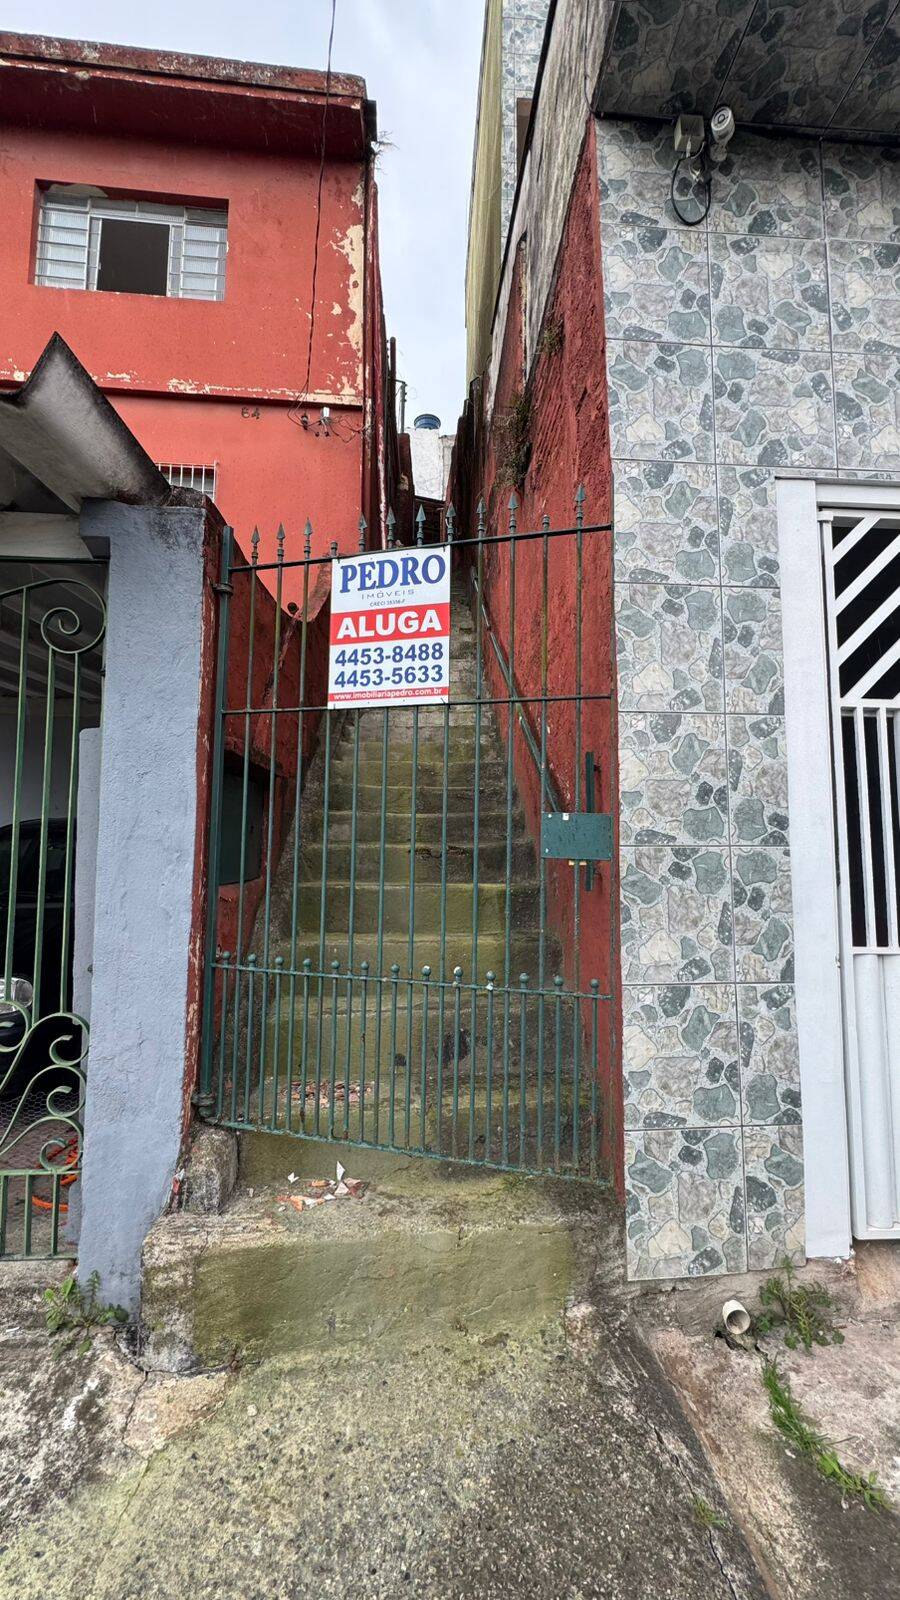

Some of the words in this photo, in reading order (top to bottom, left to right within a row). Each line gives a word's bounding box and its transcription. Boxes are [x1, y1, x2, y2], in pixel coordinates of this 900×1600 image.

[339, 554, 446, 594] PEDRO
[361, 588, 415, 600] IMÓVEIS
[336, 609, 442, 640] ALUGA
[335, 642, 444, 667] 4453-8488
[334, 664, 444, 688] 4453-5633
[333, 687, 443, 701] www.imobiliariapedro.com.br
